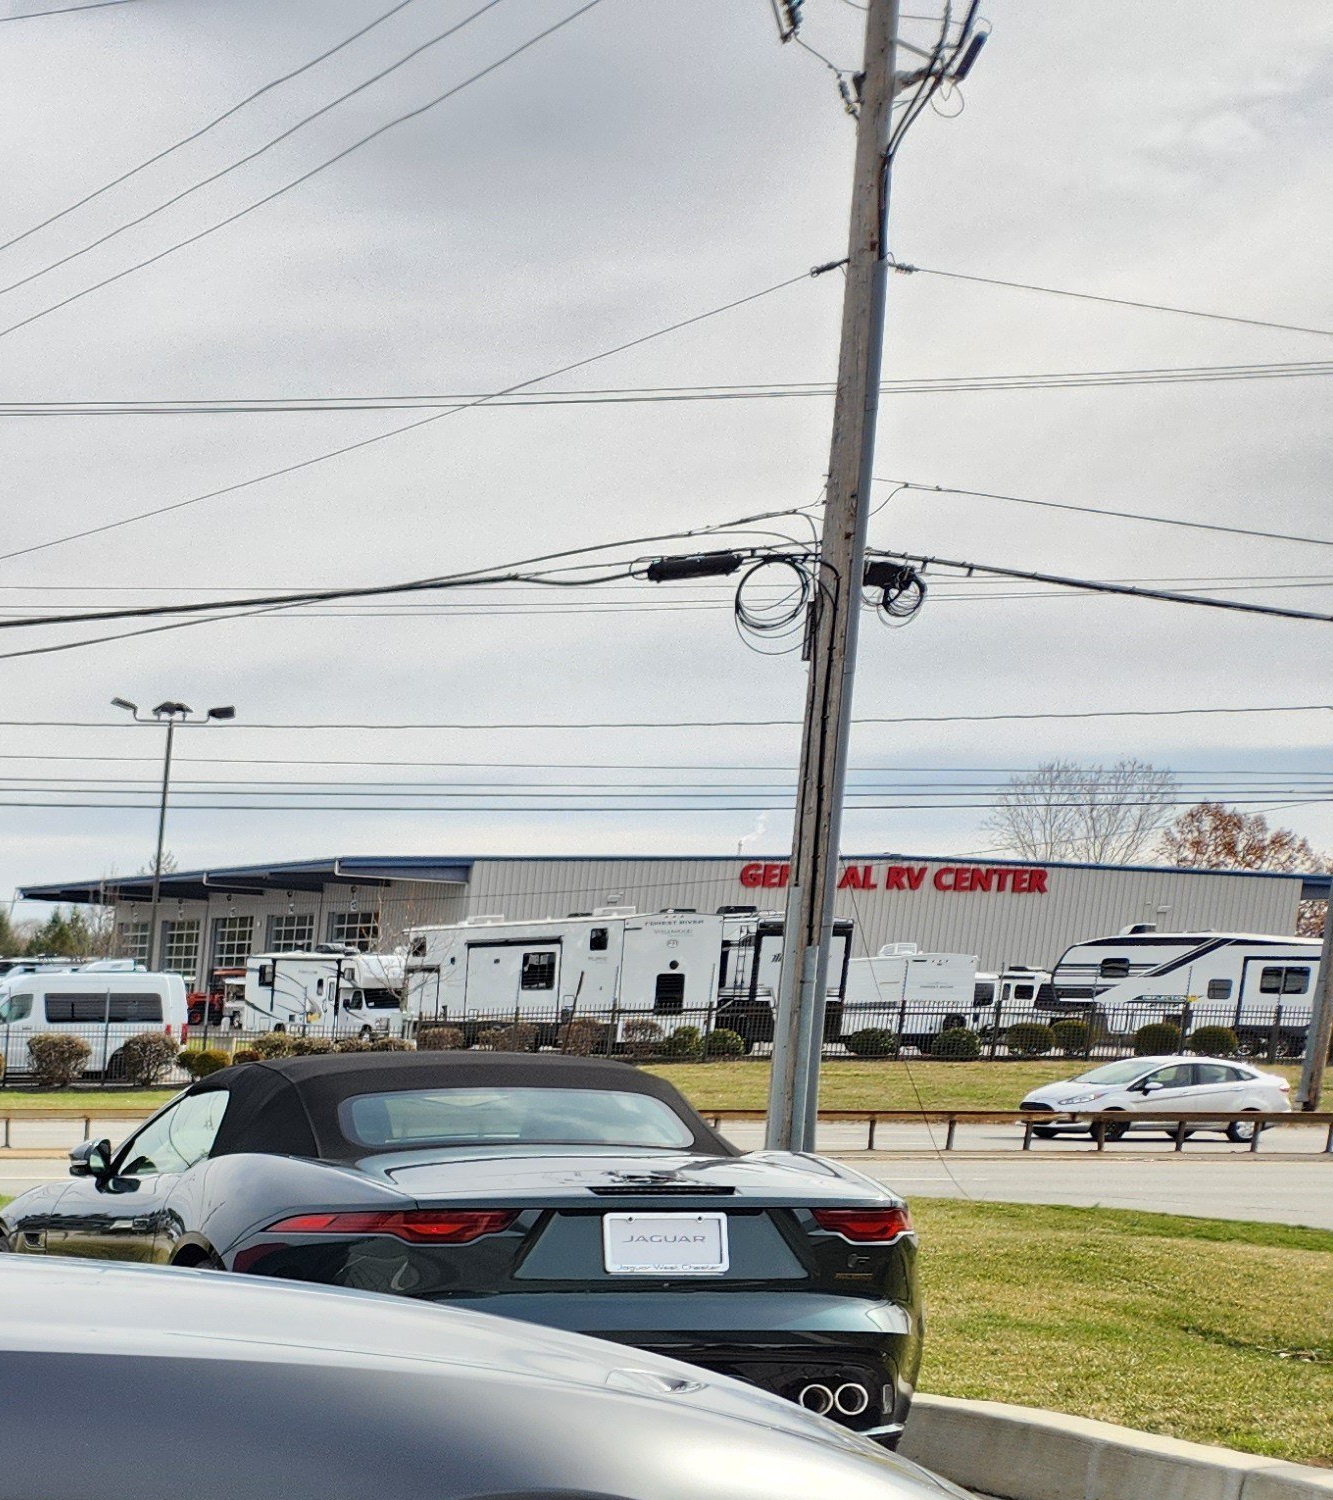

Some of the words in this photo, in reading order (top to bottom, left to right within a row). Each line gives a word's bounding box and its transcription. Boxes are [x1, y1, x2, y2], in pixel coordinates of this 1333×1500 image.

[740, 863, 877, 889] GEAL
[886, 866, 928, 891] RV
[934, 867, 1048, 894] CENTER
[622, 1234, 707, 1244] JAGUAR
[617, 1264, 651, 1273] Jaguar
